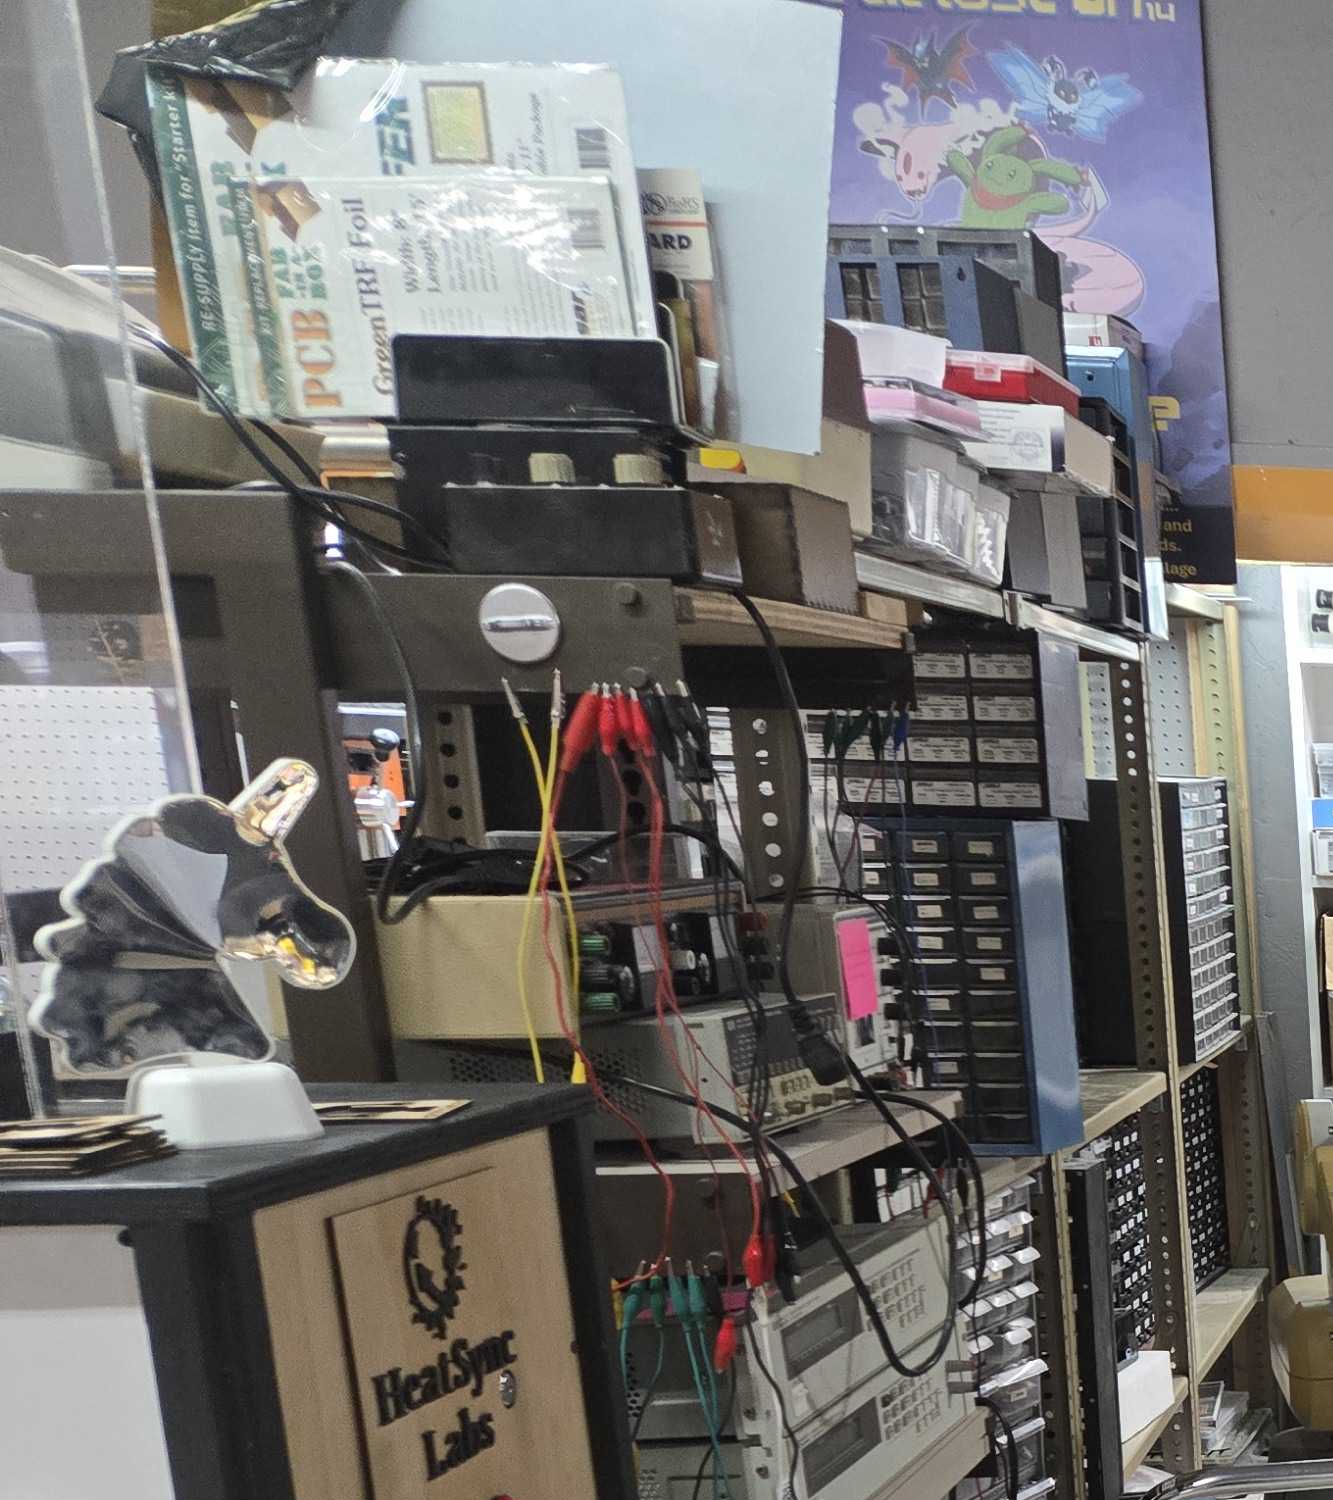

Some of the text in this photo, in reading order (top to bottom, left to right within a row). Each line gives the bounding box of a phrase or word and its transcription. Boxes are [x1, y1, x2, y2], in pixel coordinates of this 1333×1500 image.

[178, 176, 193, 199] for
[341, 198, 371, 248] Foil
[271, 246, 296, 299] FAB
[302, 245, 327, 299] BOX
[291, 309, 343, 408] PCB
[1163, 519, 1193, 533] and
[371, 1329, 518, 1427] HeatSync
[421, 1407, 496, 1482] Labs
